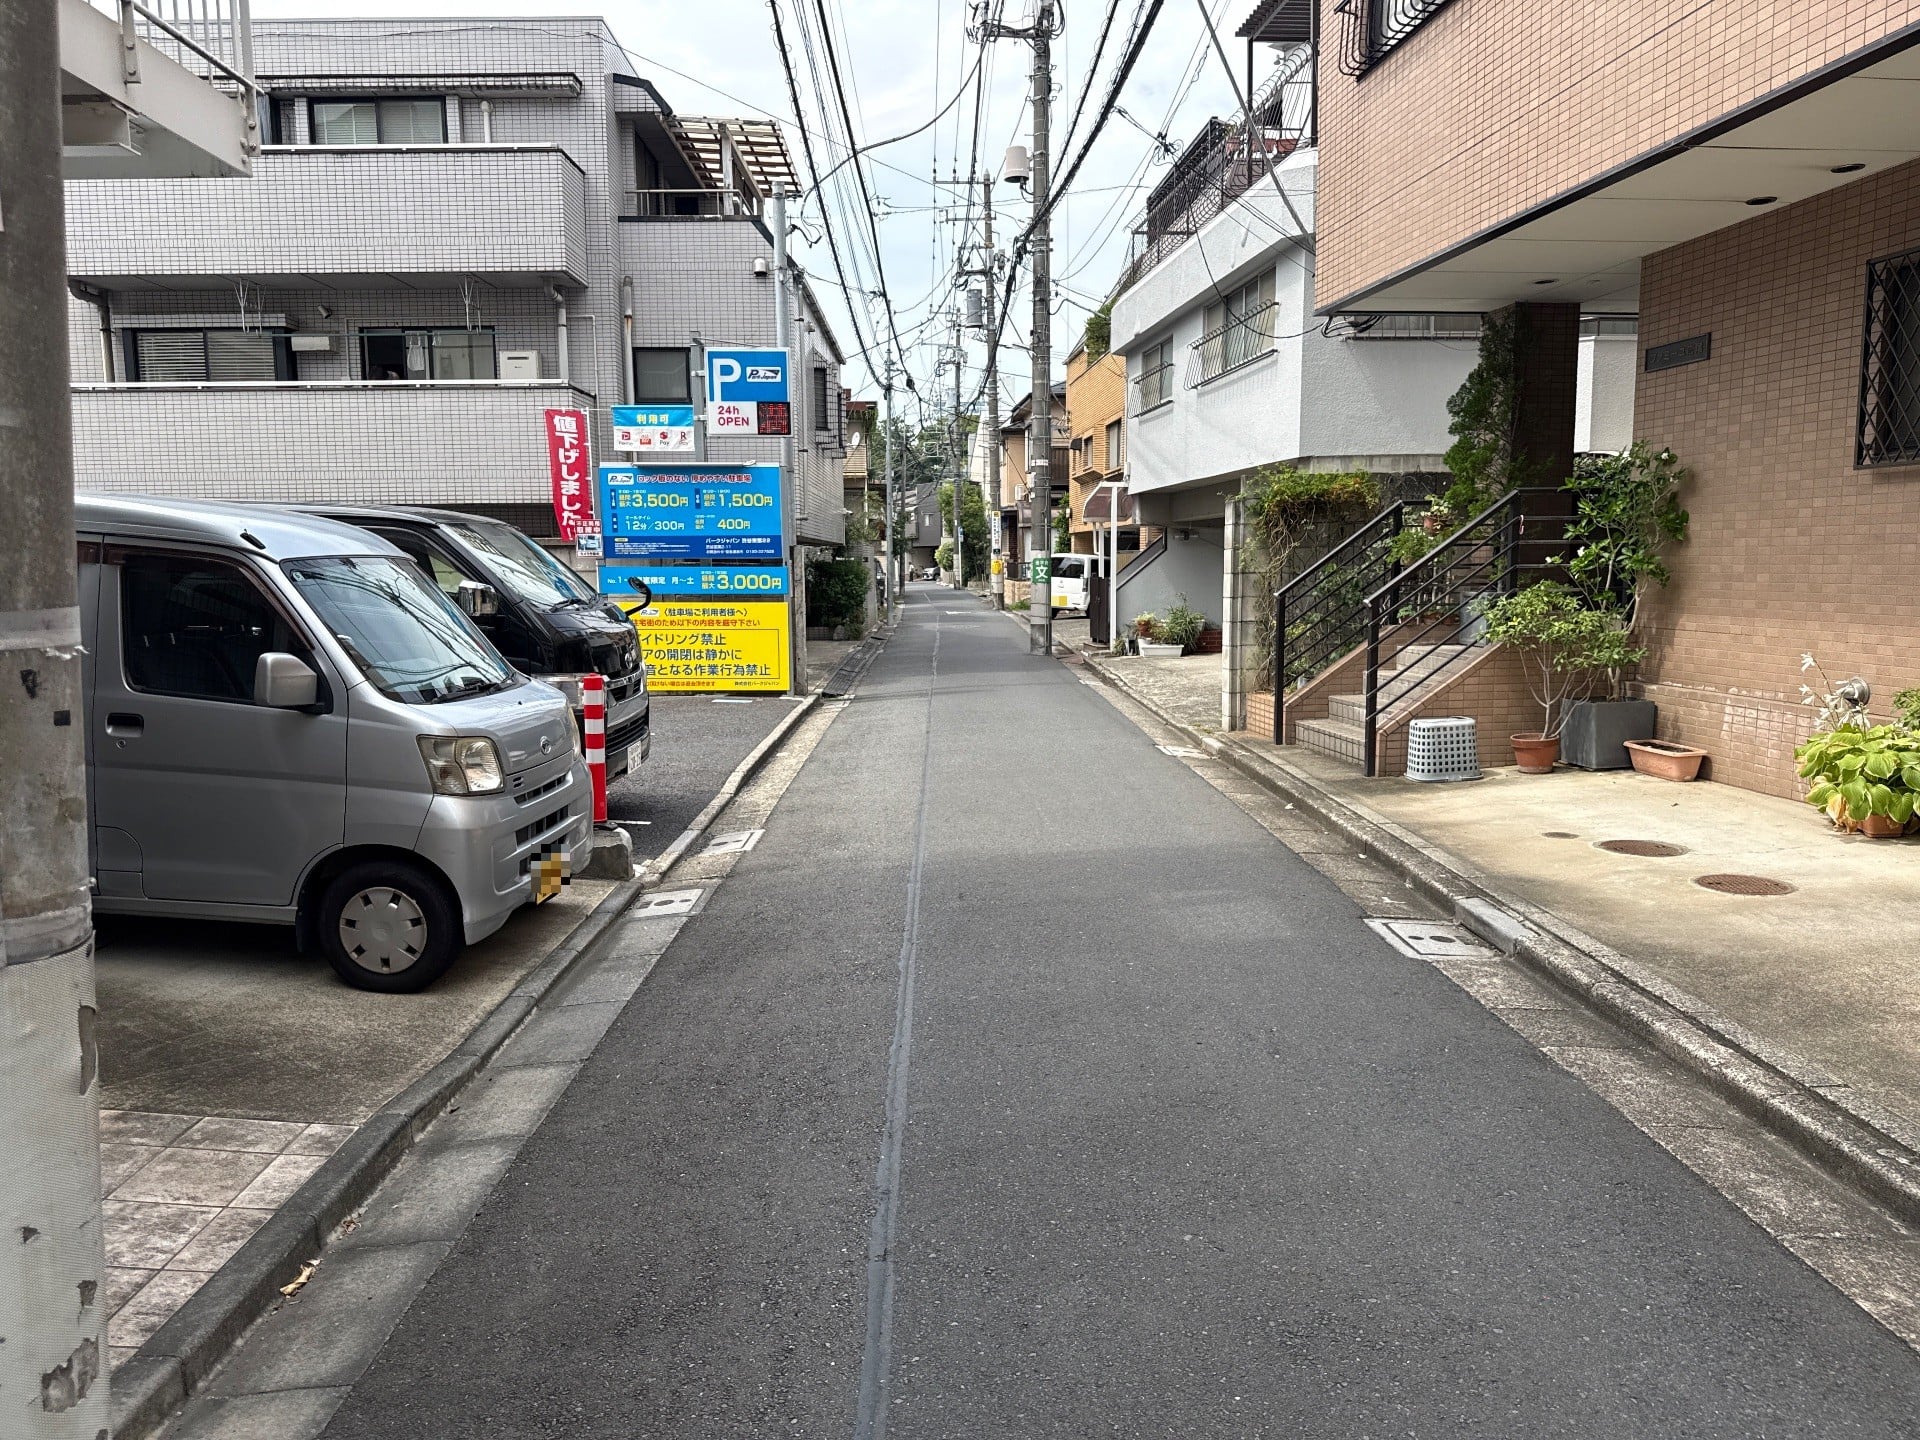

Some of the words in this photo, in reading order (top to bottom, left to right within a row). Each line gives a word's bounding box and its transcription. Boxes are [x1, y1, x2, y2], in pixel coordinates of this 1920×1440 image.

[713, 358, 742, 401] P
[718, 405, 740, 415] 24h
[636, 413, 669, 425] 利用可
[718, 416, 750, 426] OPEN
[632, 493, 689, 509] 3,500円
[719, 493, 773, 508] 1,500円
[717, 518, 751, 530] 400円
[1035, 564, 1049, 579] 文
[716, 574, 782, 590] 3,000円
[640, 633, 727, 646] イドリング禁止
[642, 648, 743, 661] アの開閉は静かに
[645, 663, 771, 677] 音となる作業行為禁止
